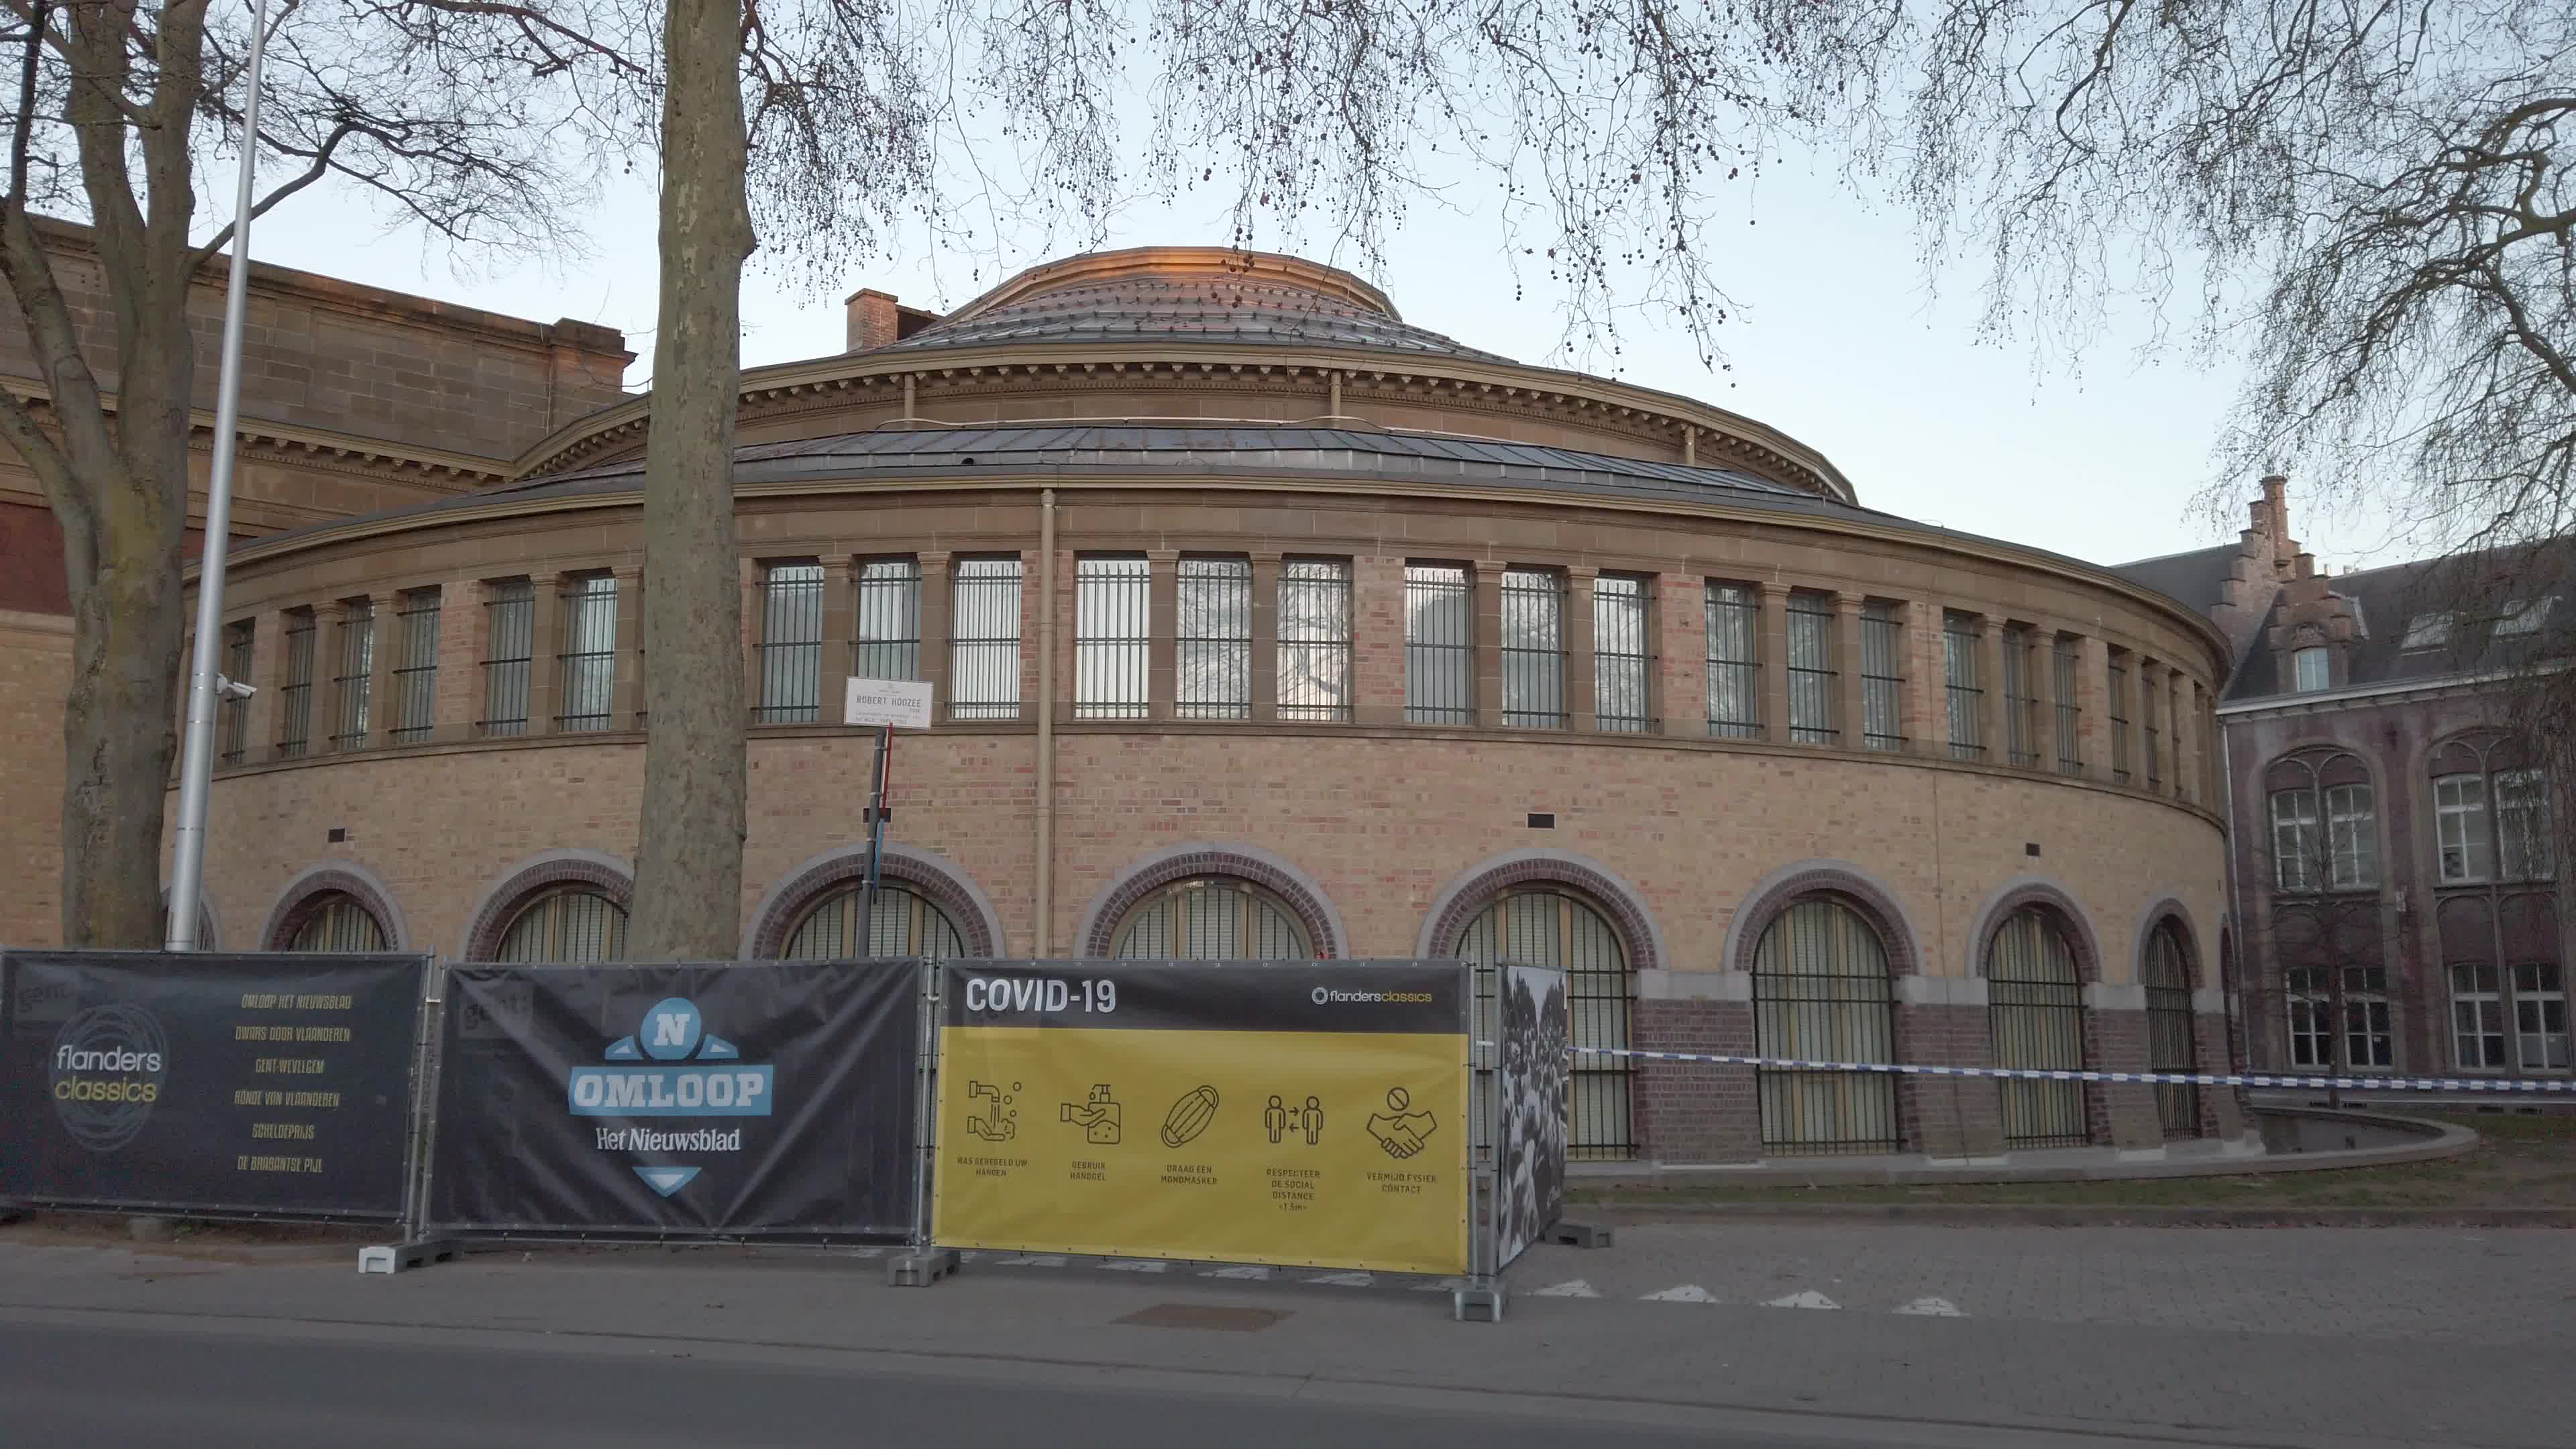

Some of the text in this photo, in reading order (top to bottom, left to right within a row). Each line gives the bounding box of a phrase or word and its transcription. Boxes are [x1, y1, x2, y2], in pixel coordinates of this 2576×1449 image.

[857, 696, 922, 708] ROBERT HOOZEE
[241, 994, 352, 1010] OMLOOP HET NIEUWSBLAD
[967, 979, 1116, 1013] COVID-19
[235, 1026, 350, 1041] DWARS DOOR VLAANDEREN
[654, 1014, 690, 1046] N
[57, 1044, 161, 1072] flanders
[256, 1059, 325, 1074] GENT-WEVELGEM
[55, 1075, 156, 1102] classics
[574, 1073, 763, 1107] OMLOOP
[235, 1090, 340, 1106] RONDE VAN VLAANDEREN
[252, 1123, 315, 1139] SCHELDEPRIJS
[596, 1128, 741, 1152] Het Nieuwsblad
[237, 1156, 322, 1173] DE BRABANTSE PIJL
[957, 1157, 973, 1165] WAS
[1015, 1159, 1028, 1167] UW
[1167, 1165, 1212, 1173] DRAAG EEN
[1161, 1175, 1218, 1185] MONDMASKER
[1267, 1169, 1321, 1178] RESPECTEER
[1366, 1173, 1405, 1181] VERMIJD
[1271, 1180, 1315, 1189] DE SOCIAL
[1382, 1184, 1421, 1194] CONTACT
[1273, 1191, 1315, 1201] DISTANCE
